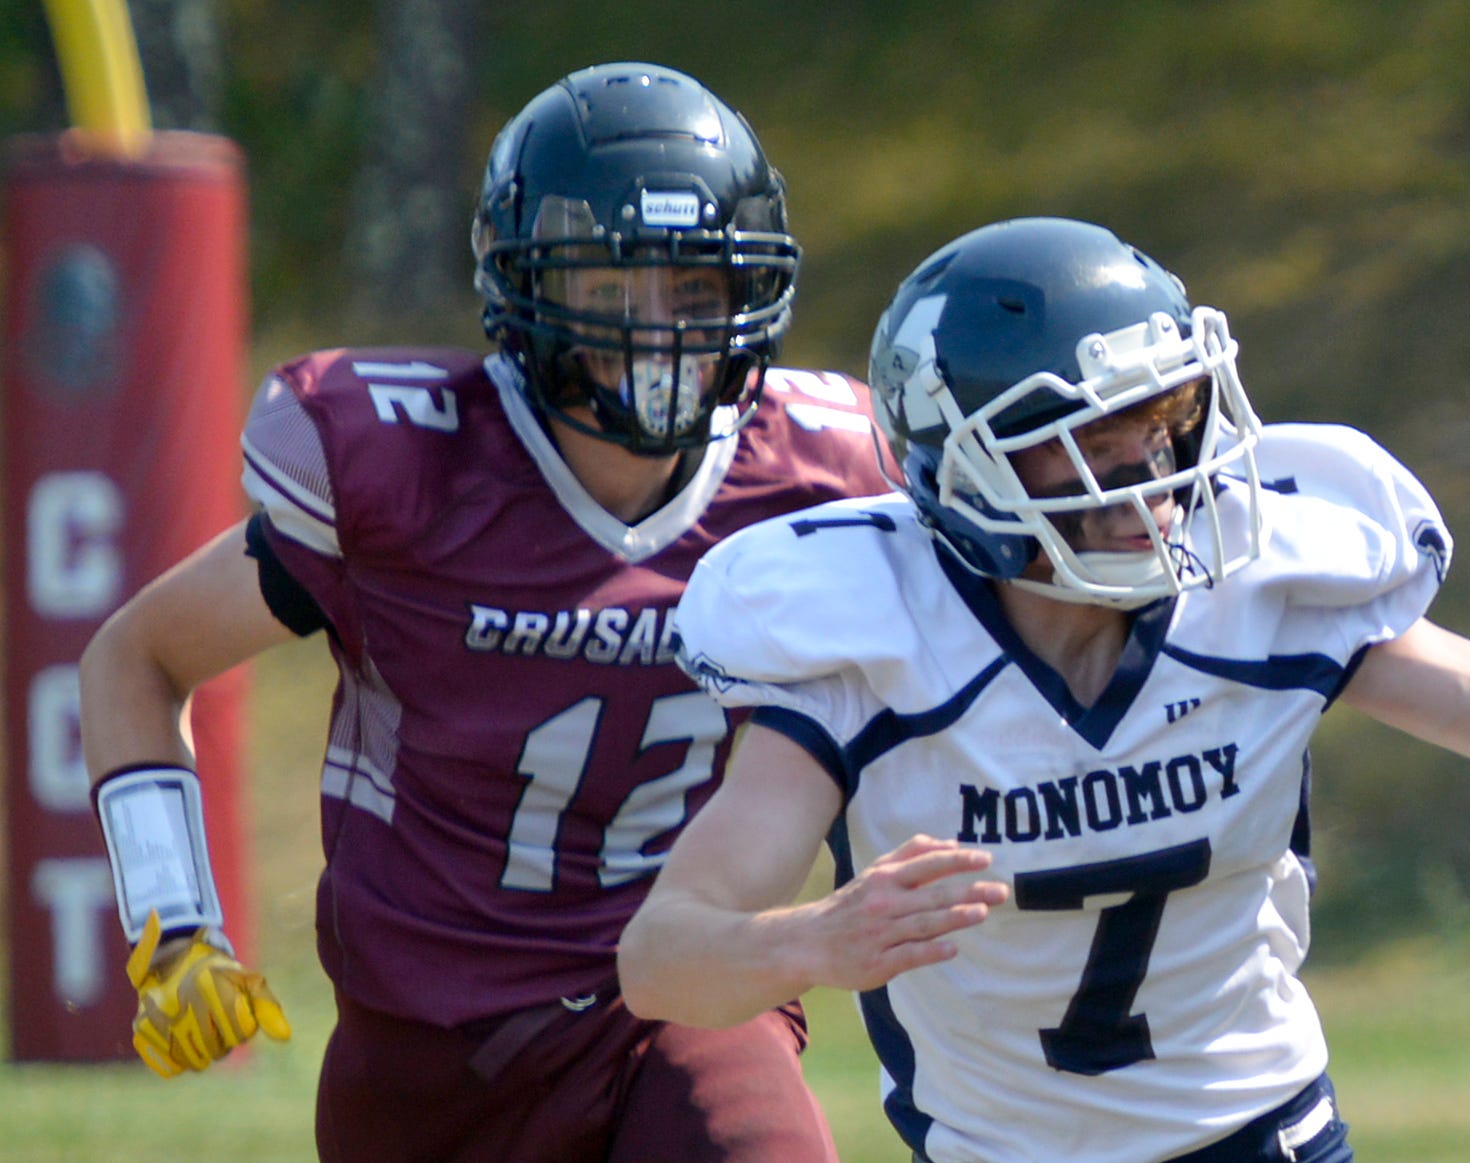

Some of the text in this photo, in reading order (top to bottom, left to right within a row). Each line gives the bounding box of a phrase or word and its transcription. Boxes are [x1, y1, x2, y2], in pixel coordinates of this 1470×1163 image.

[352, 361, 459, 432] 12
[500, 690, 728, 892] 12
[957, 743, 1242, 845] MONOMOY
[1014, 837, 1213, 1077] 7
